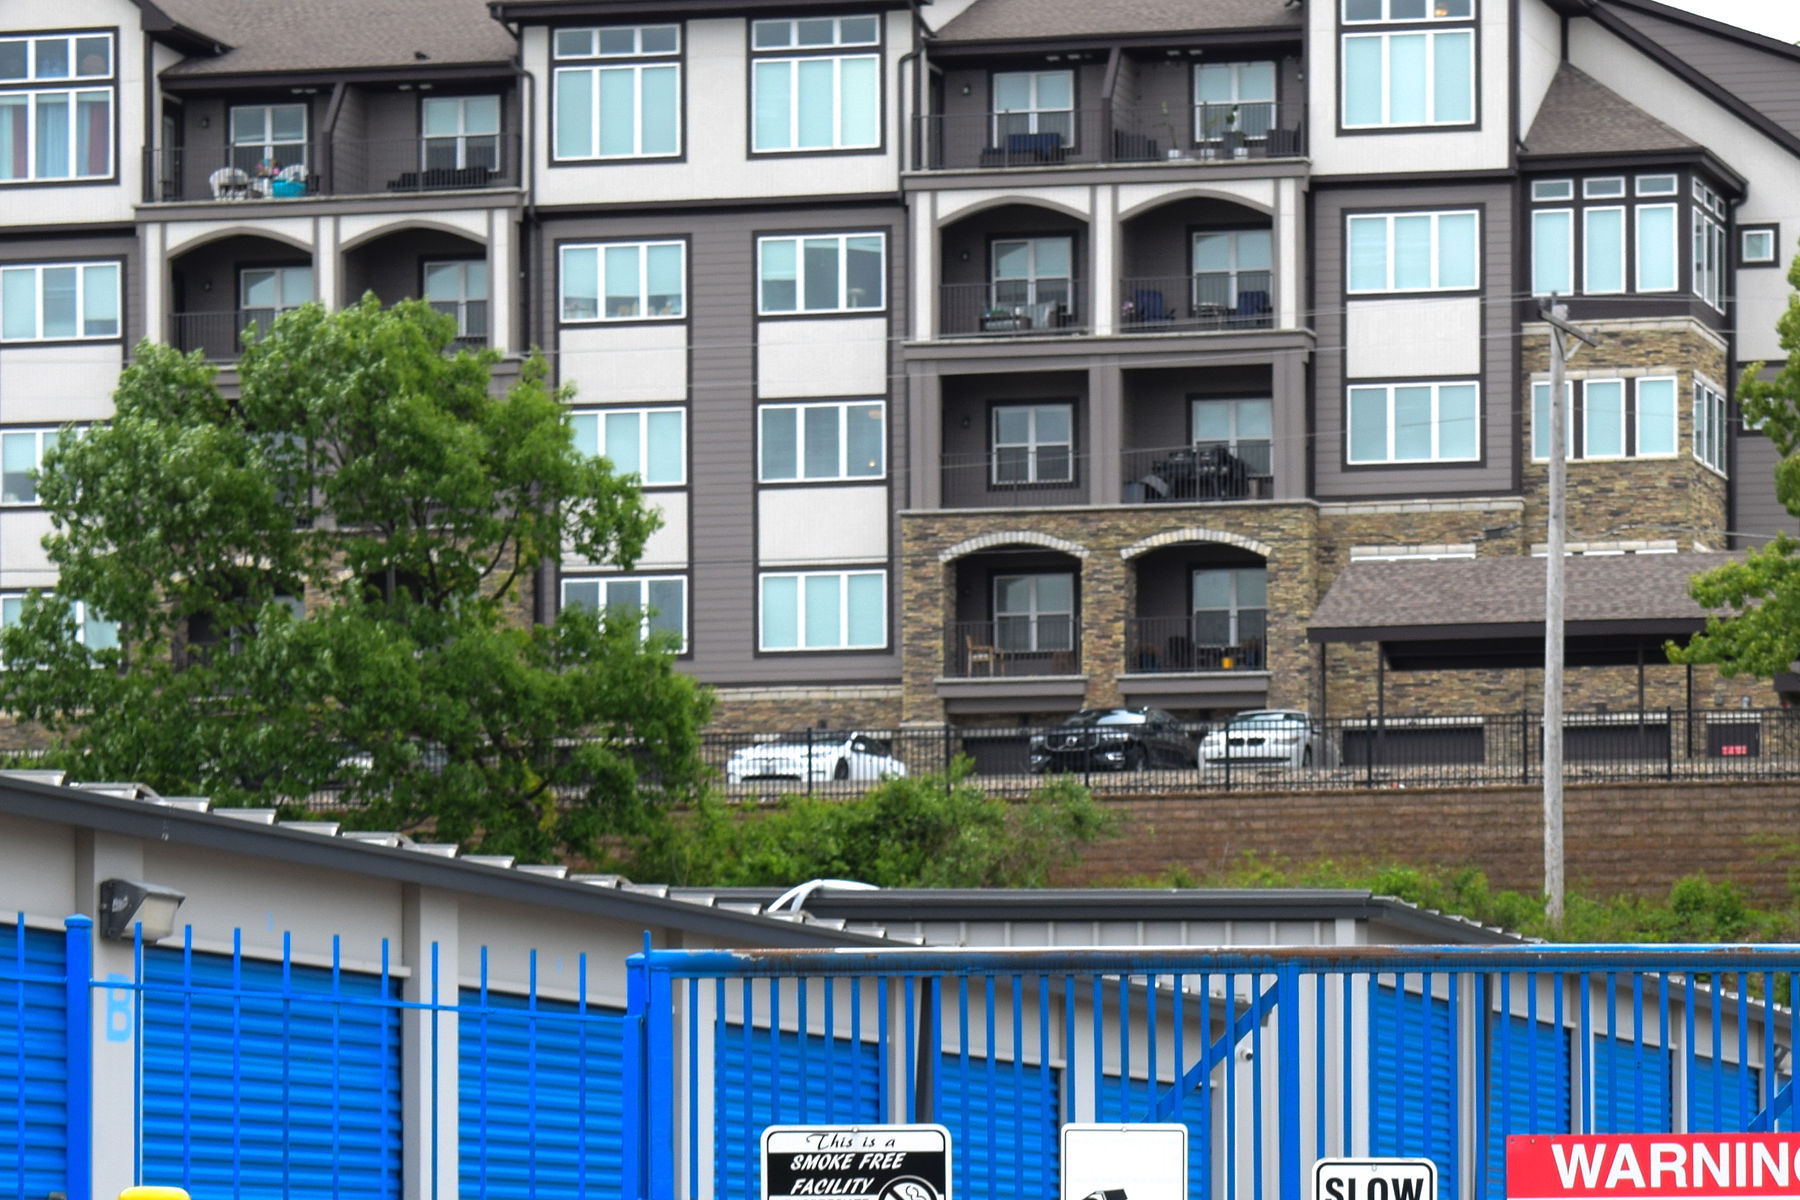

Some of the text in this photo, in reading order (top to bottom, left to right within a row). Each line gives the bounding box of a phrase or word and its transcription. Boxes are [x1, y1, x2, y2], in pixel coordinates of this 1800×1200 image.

[106, 973, 132, 1043] B
[806, 1133, 895, 1150] This is a
[790, 1153, 907, 1171] SMOKE FREE
[790, 1178, 875, 1195] FACILITY
